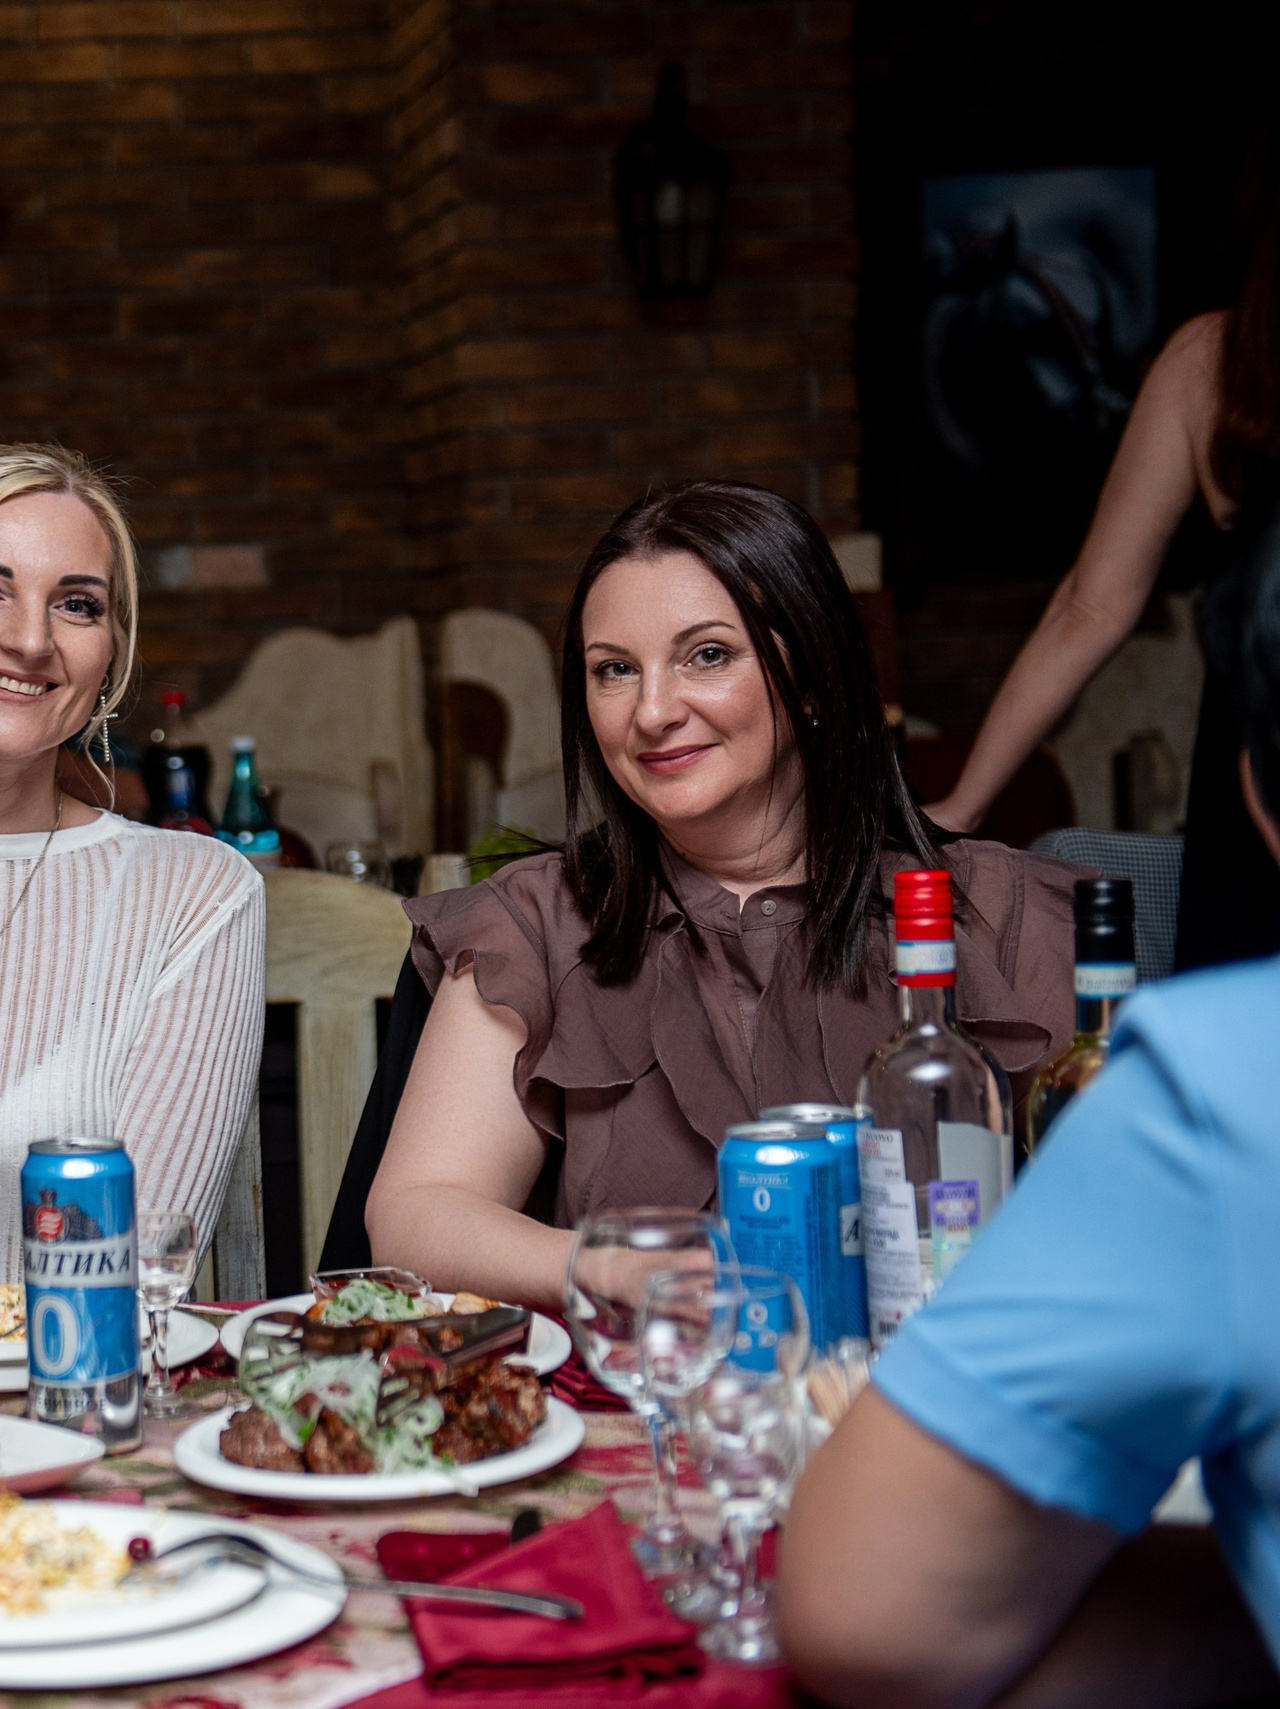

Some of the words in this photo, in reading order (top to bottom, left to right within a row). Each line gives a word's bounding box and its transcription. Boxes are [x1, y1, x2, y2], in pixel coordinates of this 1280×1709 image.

[753, 1185, 771, 1213] 0
[24, 1247, 130, 1276] АЛТИКА
[30, 1292, 81, 1379] 0
